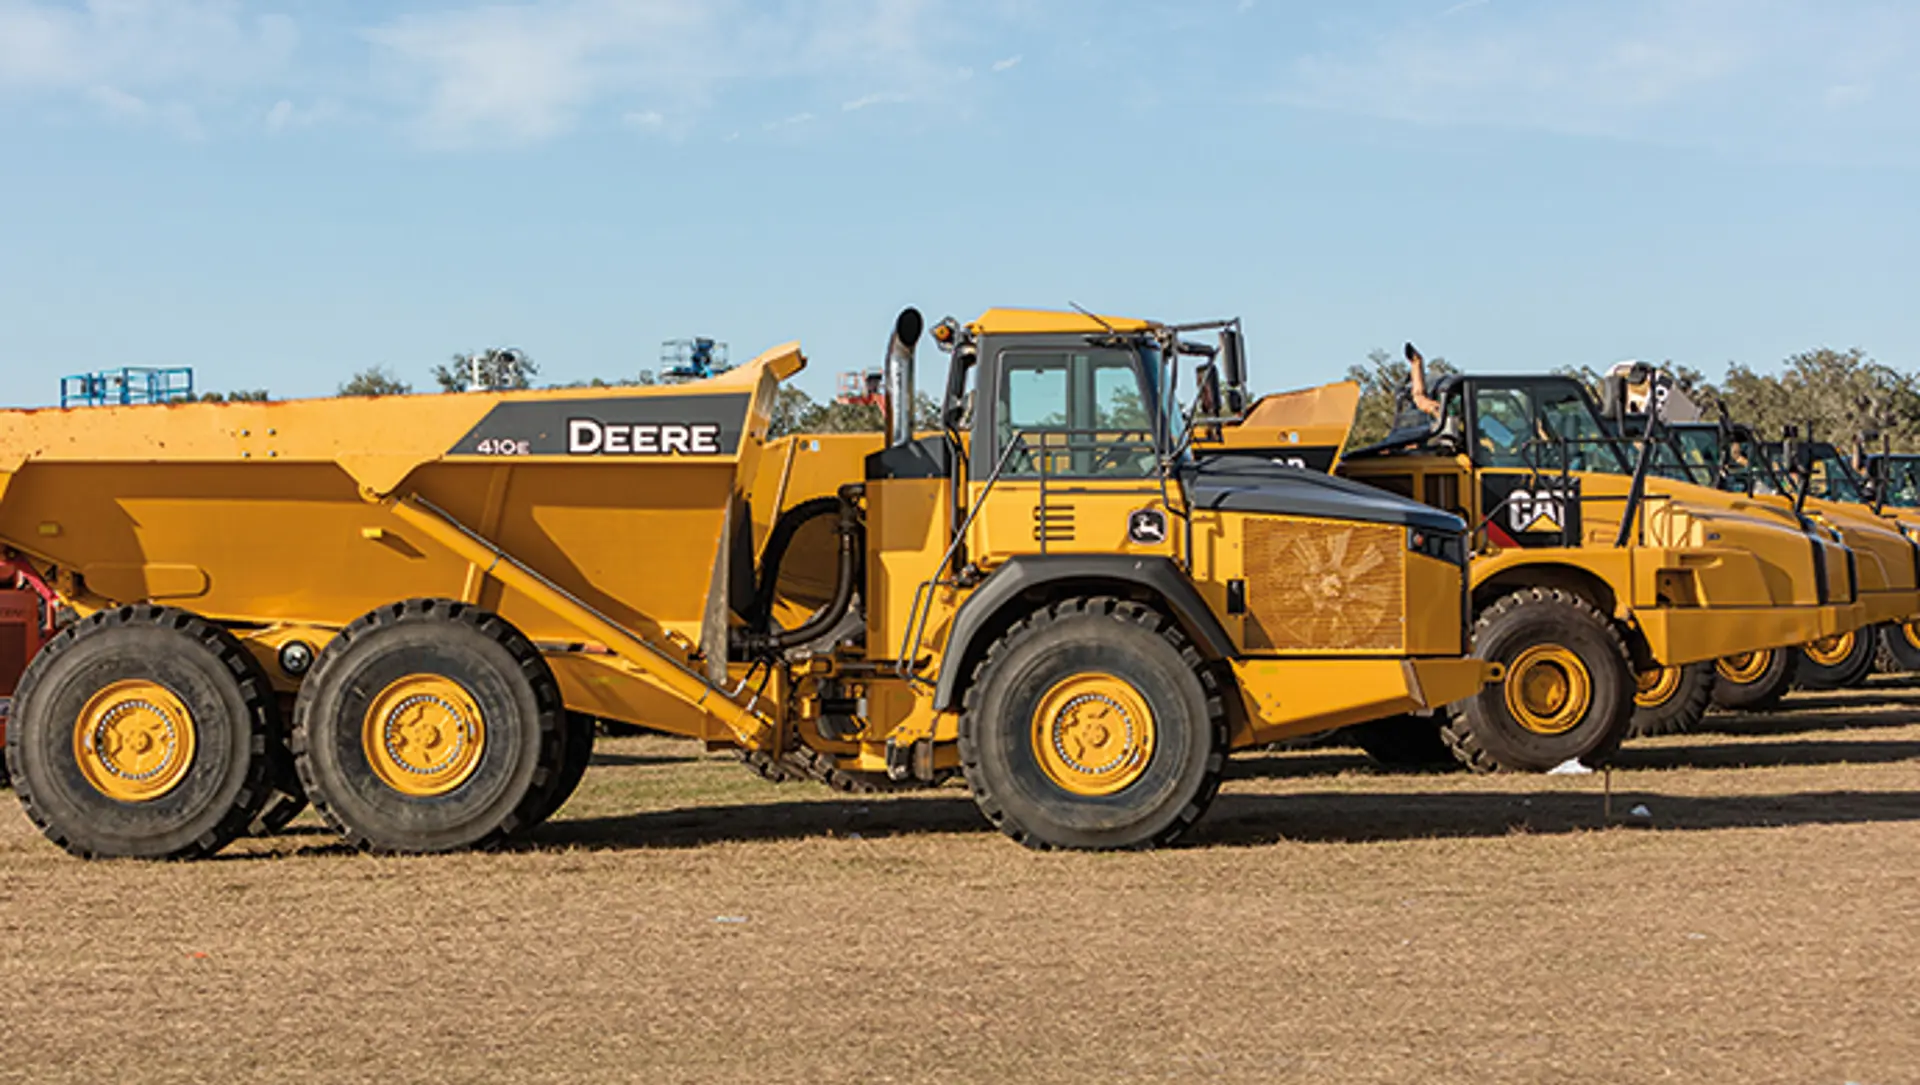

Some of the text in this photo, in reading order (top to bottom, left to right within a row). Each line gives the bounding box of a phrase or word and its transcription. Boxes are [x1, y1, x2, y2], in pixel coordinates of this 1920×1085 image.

[476, 419, 718, 455] 410E DEERE
[1509, 489, 1573, 532] CAT
